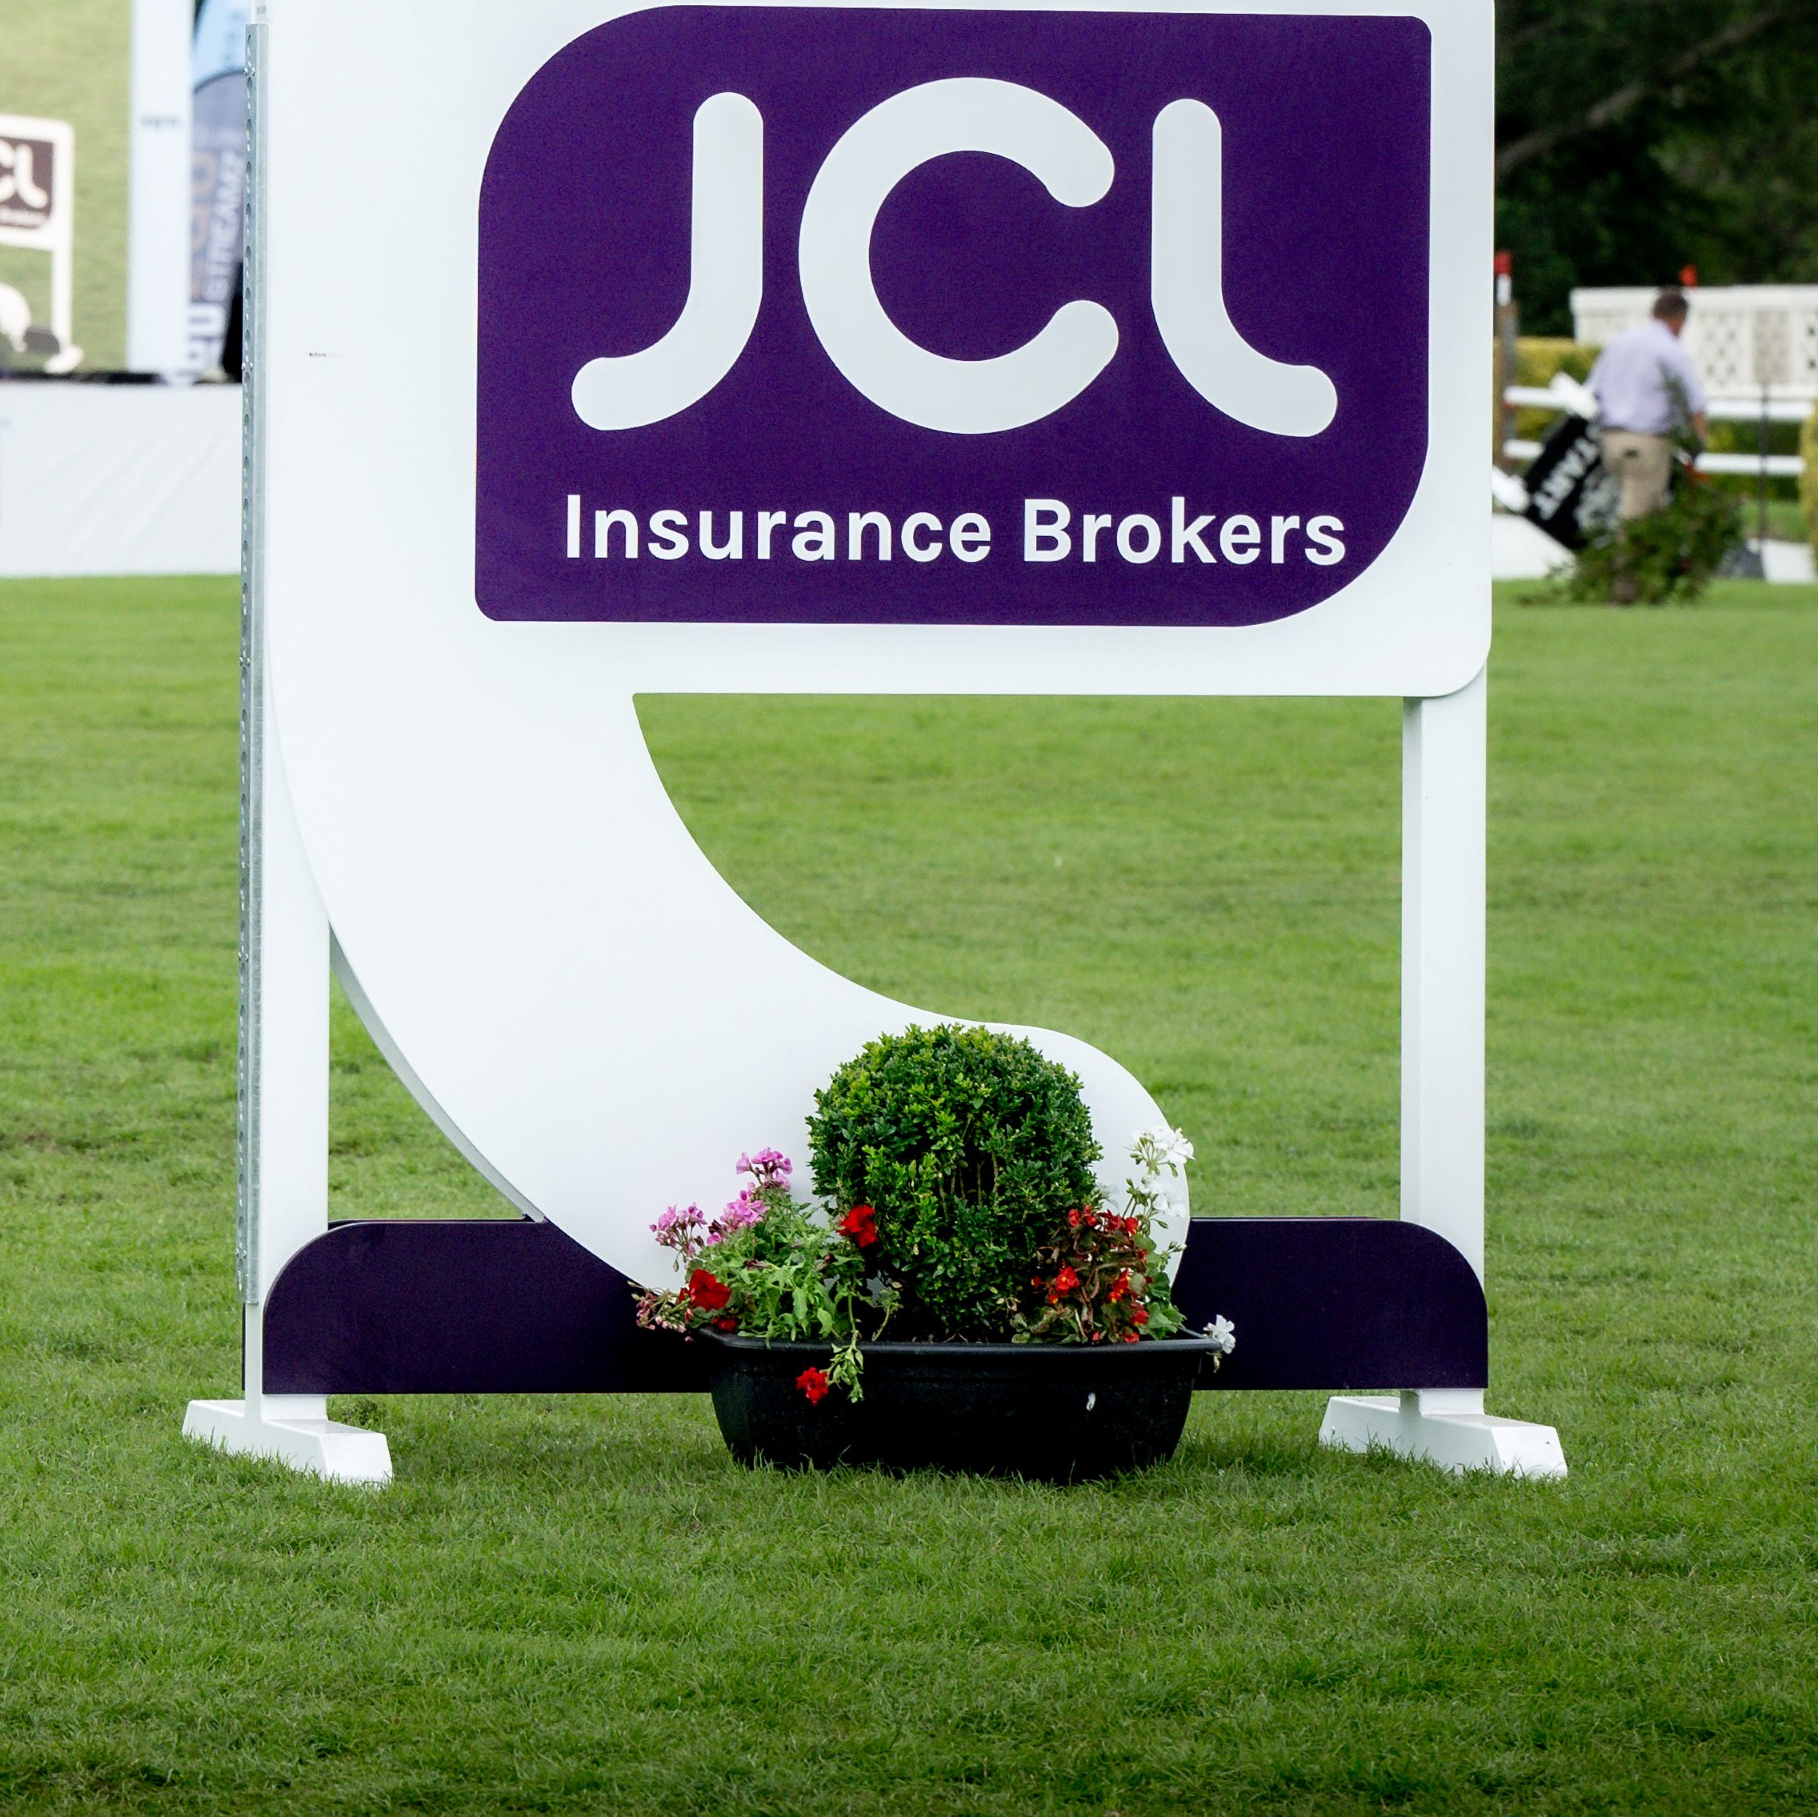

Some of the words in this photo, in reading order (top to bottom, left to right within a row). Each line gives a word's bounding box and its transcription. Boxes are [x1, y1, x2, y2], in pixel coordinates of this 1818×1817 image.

[572, 76, 1338, 438] JCL
[566, 494, 991, 563] Insurance
[1023, 496, 1346, 567] Brokers
